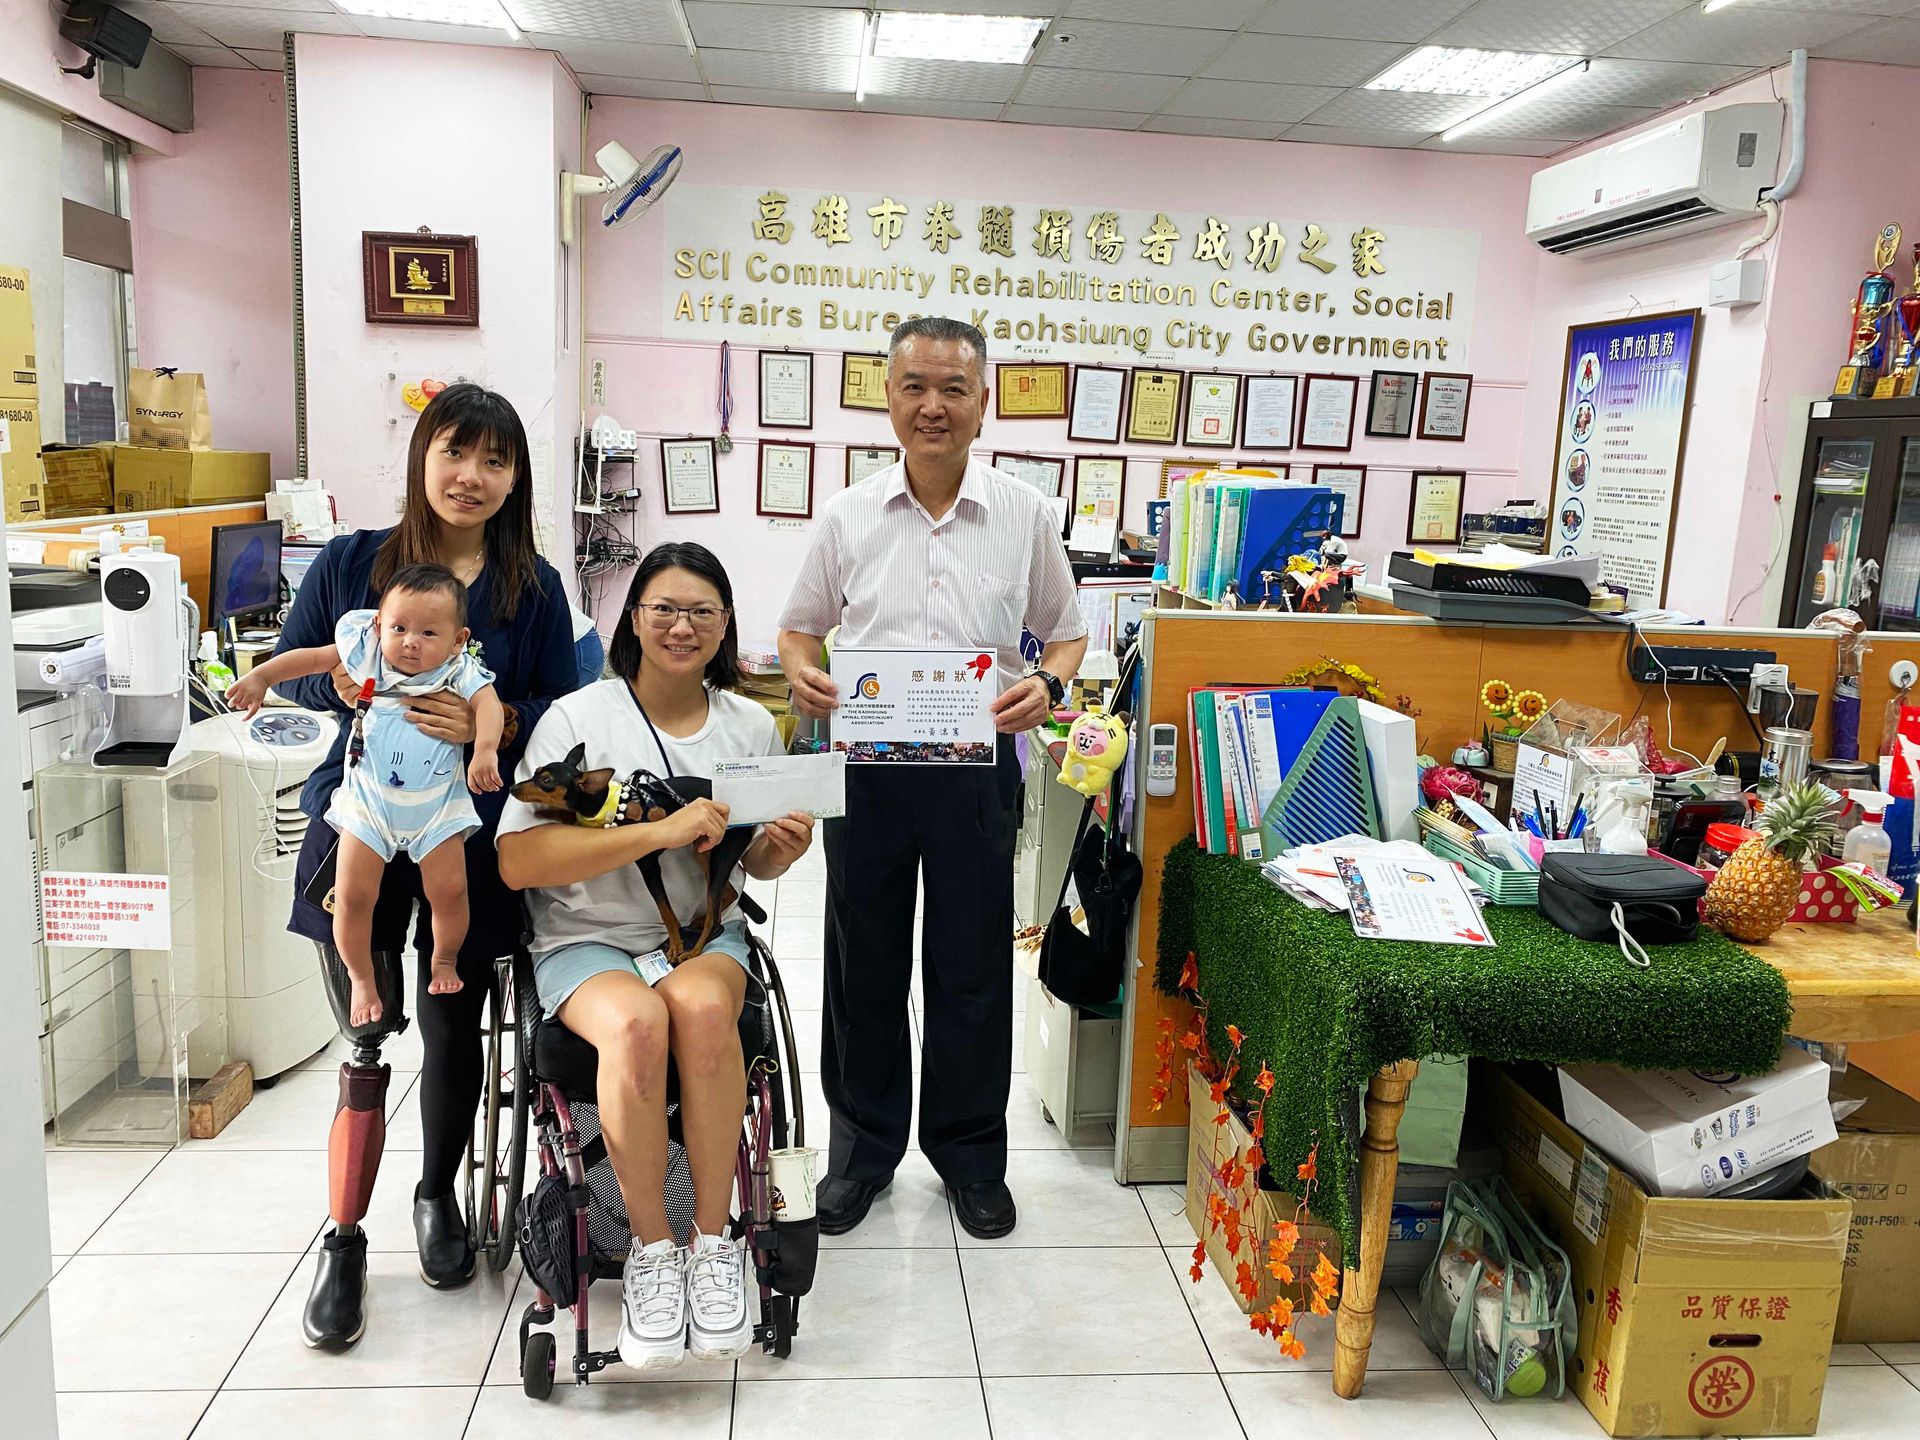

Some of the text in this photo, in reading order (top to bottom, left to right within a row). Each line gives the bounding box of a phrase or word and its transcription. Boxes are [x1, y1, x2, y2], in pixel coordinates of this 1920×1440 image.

[753, 191, 1387, 278] 高雄市脊髓損傷者成功之家
[675, 248, 1454, 320] SCI Community Rehabilitation Center, Social
[675, 292, 1449, 361] Affairs Bure Kaohsiung City Government
[1609, 331, 1675, 361] 我們的服務
[136, 407, 183, 419] SYNERGY
[911, 670, 967, 682] 感謝狀
[1681, 1295, 1791, 1321] 品質保證
[1702, 1365, 1742, 1410] 榮
